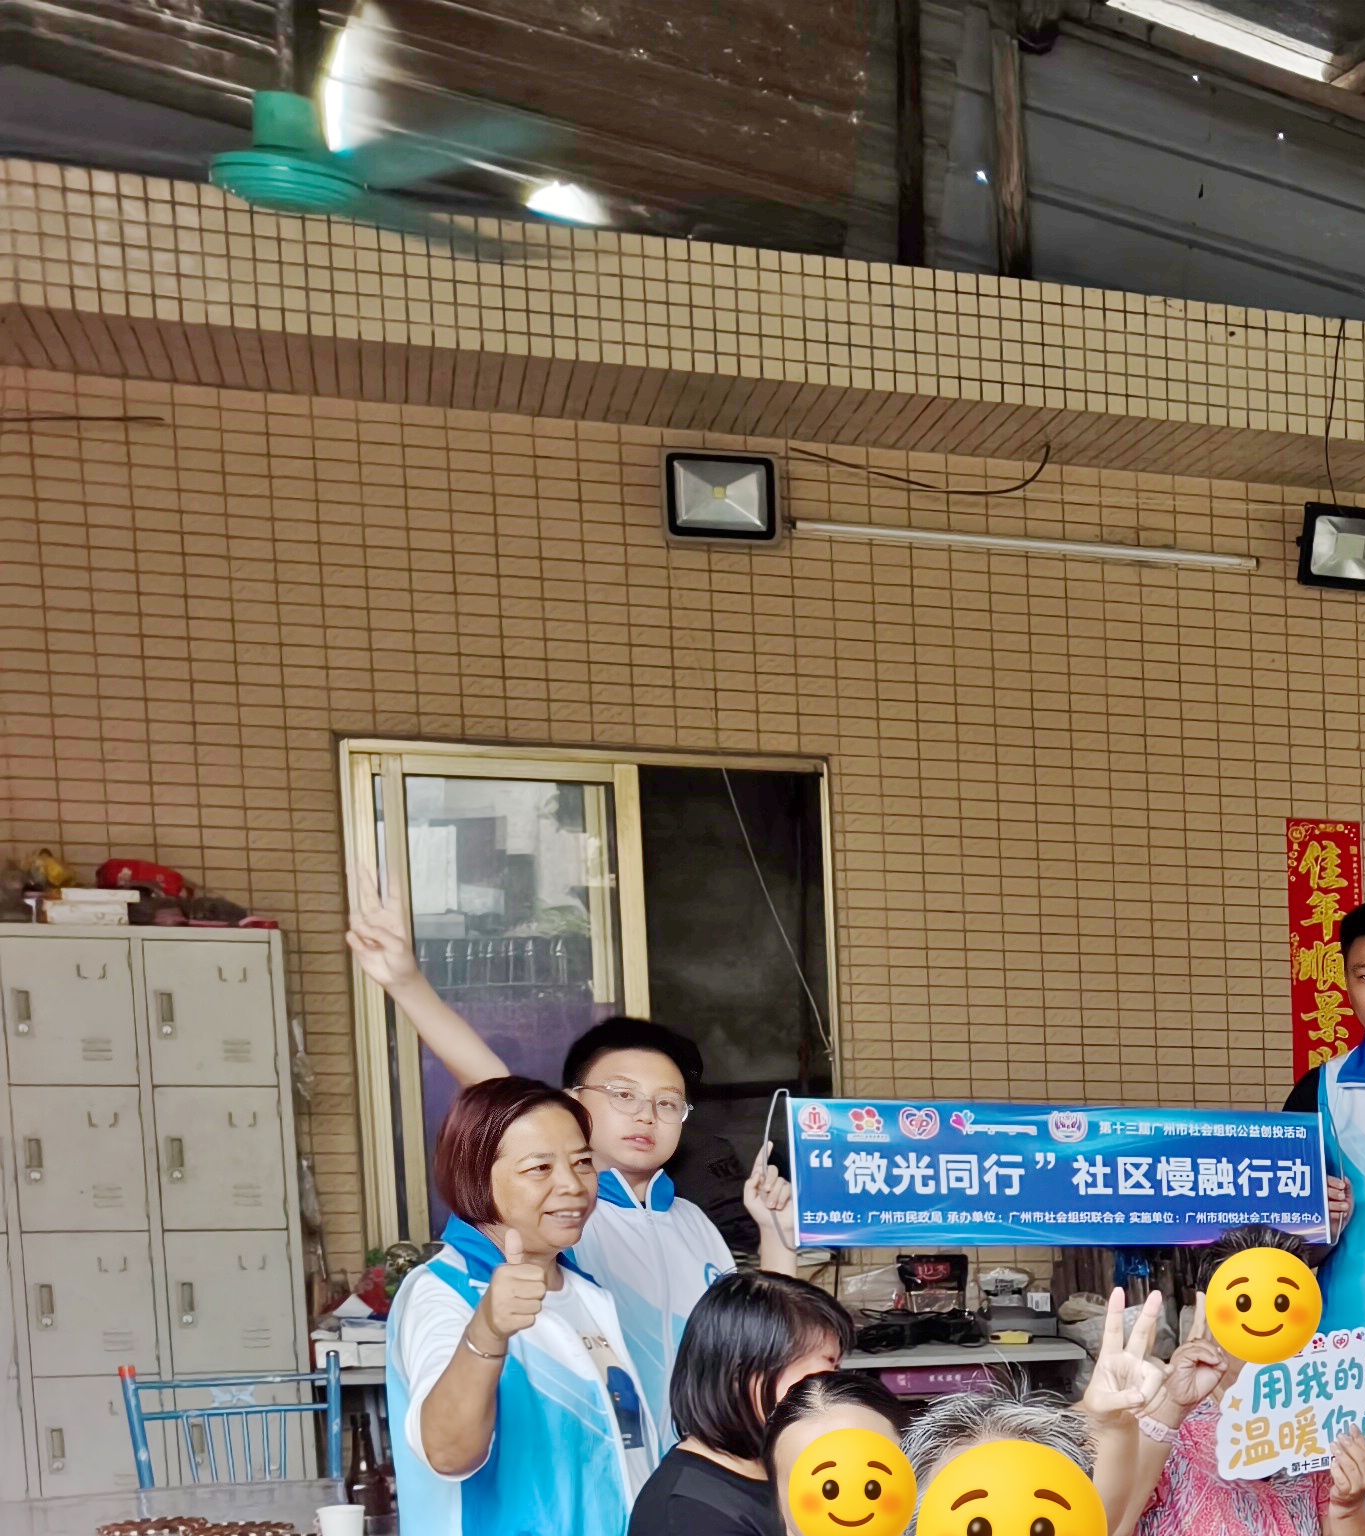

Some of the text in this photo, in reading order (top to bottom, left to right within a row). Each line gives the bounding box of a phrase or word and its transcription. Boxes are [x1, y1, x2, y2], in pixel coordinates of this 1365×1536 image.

[1099, 1122, 1307, 1139] 第十三届广州市社会组织公益创投活动
[803, 1210, 1322, 1225] 主办单位：广州市民政局 承办单位：广州市社会组织联合会 实施单位：广州市和悦社会工作服务中心
